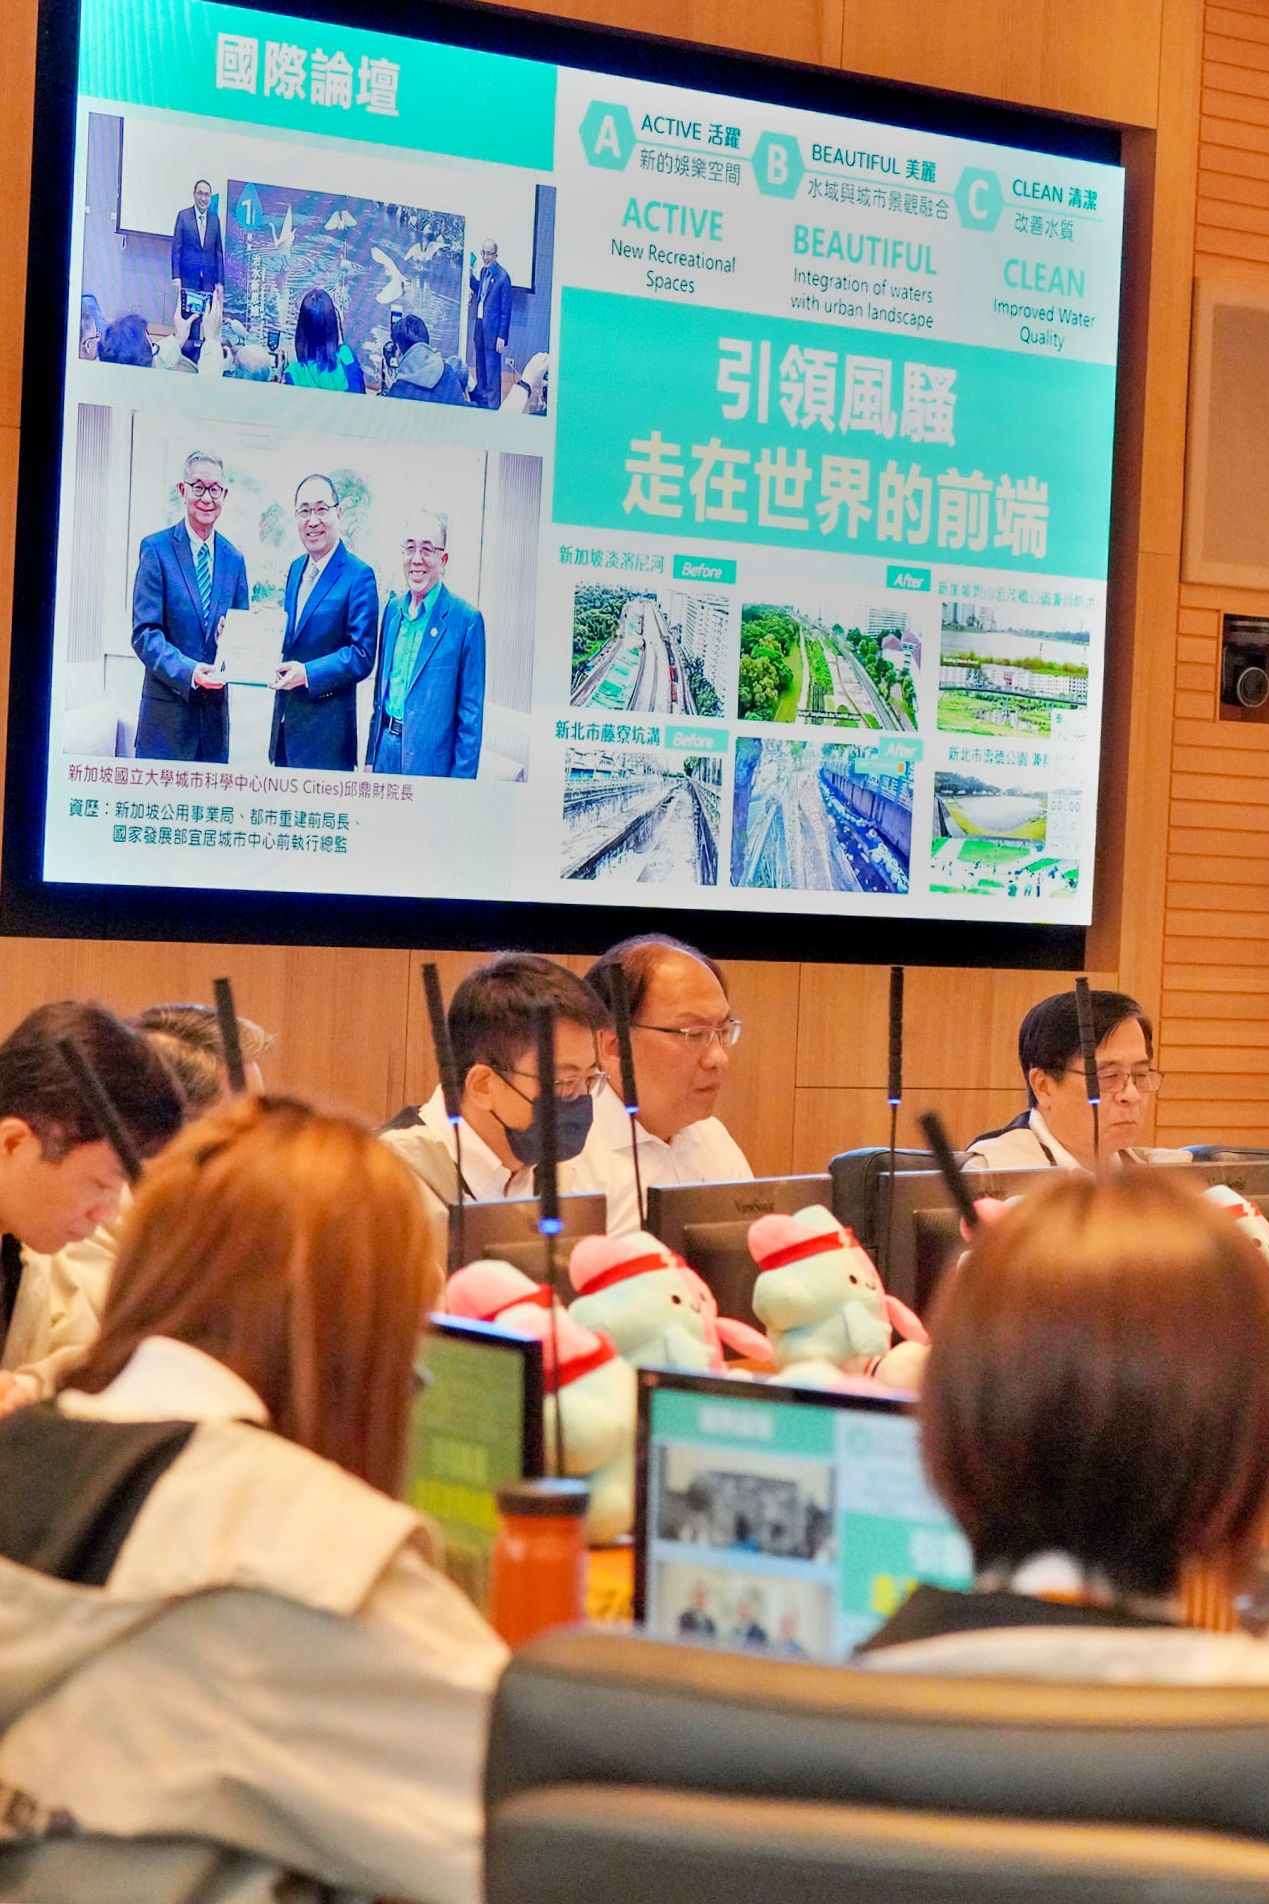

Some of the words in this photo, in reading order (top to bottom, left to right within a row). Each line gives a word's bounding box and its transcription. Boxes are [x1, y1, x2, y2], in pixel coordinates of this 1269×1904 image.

[215, 31, 402, 118] 國際論壇
[594, 114, 623, 159] A
[641, 112, 703, 142] ACTIVE
[706, 123, 741, 150] 活躍
[639, 148, 742, 187] 新的娛樂空間
[766, 143, 789, 186] B
[812, 143, 901, 177] BEAUTIFUL
[904, 157, 937, 184] 美麗
[807, 177, 950, 222] 水域與城市景觀融合
[967, 177, 990, 222] C
[1012, 178, 1064, 205] CLEAN
[1067, 186, 1098, 211] 清潔
[622, 196, 724, 242] ACTIVE
[1014, 212, 1075, 242] 改善水質
[610, 239, 644, 261] New
[647, 243, 736, 275] Recreational
[793, 223, 938, 277] BEAUTIFUL
[646, 269, 695, 295] Spaces
[793, 268, 868, 297] Integration
[871, 277, 887, 297] of
[888, 284, 933, 304] waters
[1003, 257, 1086, 300] CLEAN
[791, 292, 820, 313] with
[824, 296, 863, 318] urban
[867, 301, 934, 332] landscape
[993, 297, 1056, 328] Improved
[1059, 305, 1096, 329] Water
[1019, 325, 1065, 351] Quality
[716, 337, 958, 448] 引領風騷
[622, 431, 1050, 560] 走在世界的前端
[681, 561, 723, 579] Before
[893, 572, 925, 590] After
[68, 763, 299, 795] 新加坡國立大學城市科學中心(NUS
[113, 824, 347, 854] 國家發展部宜居城市中心前執行總監
